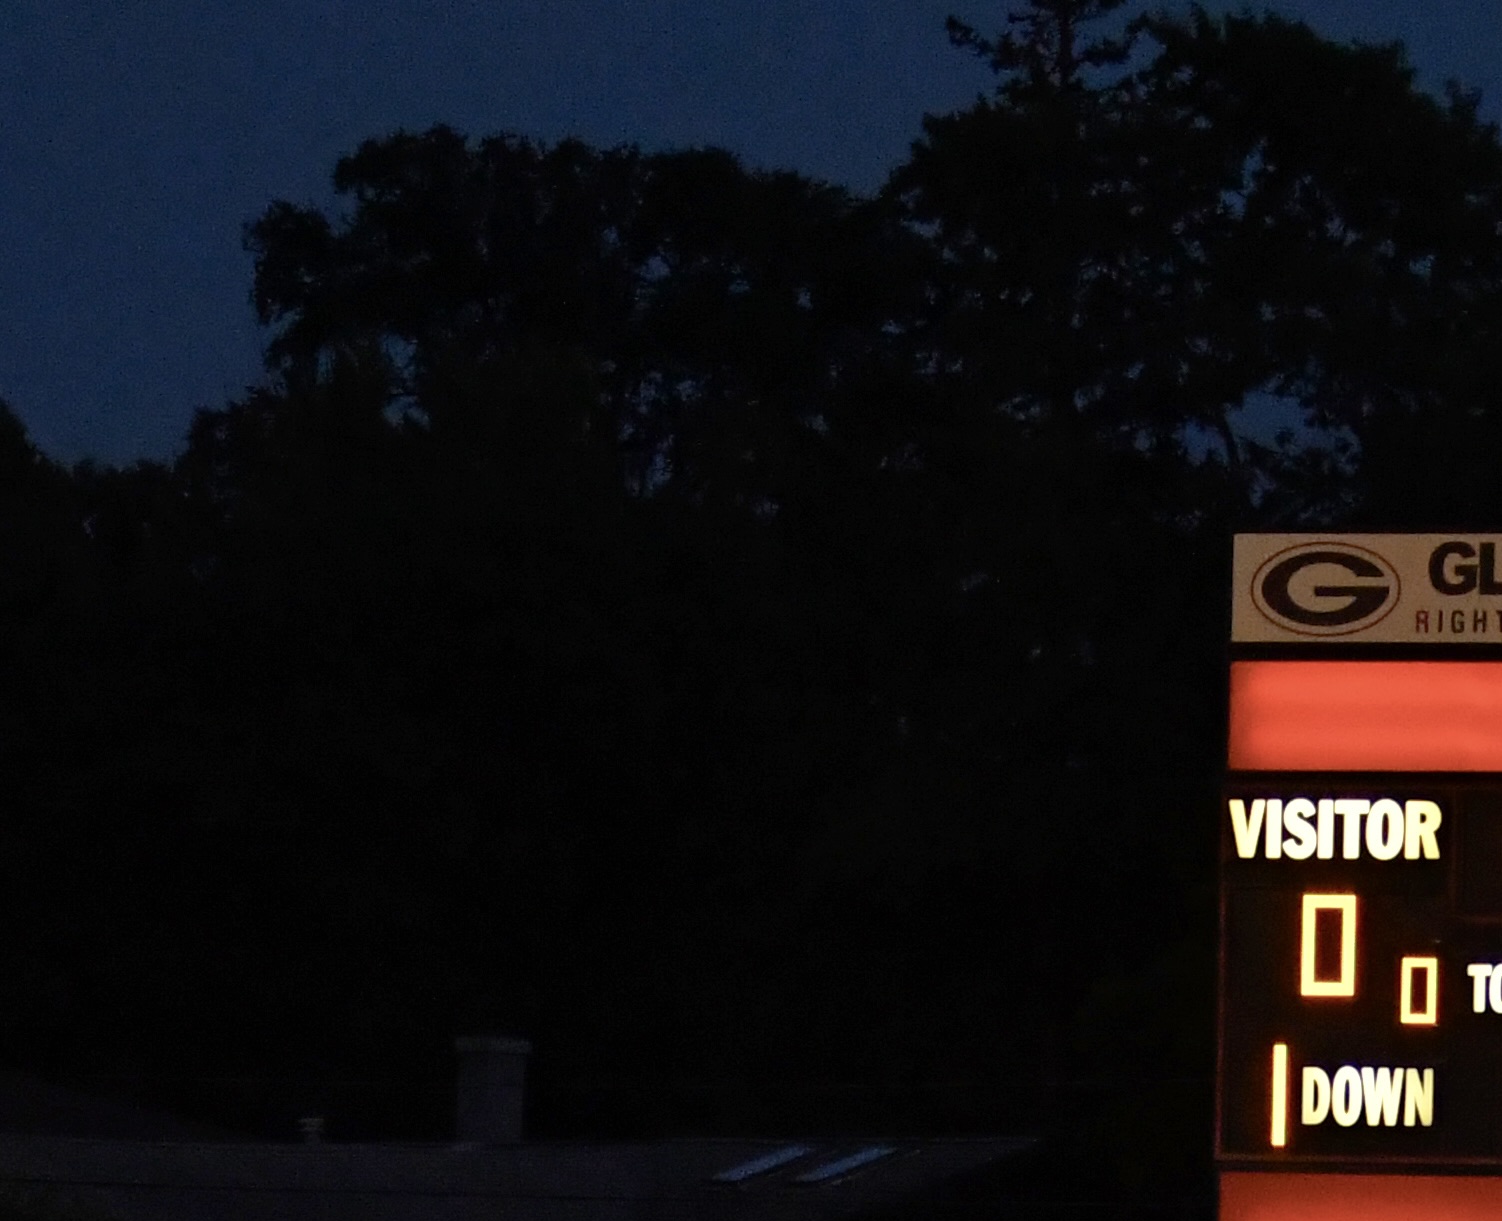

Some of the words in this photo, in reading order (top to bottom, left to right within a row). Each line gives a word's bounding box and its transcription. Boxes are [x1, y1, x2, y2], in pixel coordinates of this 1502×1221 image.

[1229, 798, 1443, 861] VISITOR
[1300, 894, 1357, 997] 0
[1400, 957, 1438, 1025] 0
[1301, 1065, 1434, 1128] DOWN
